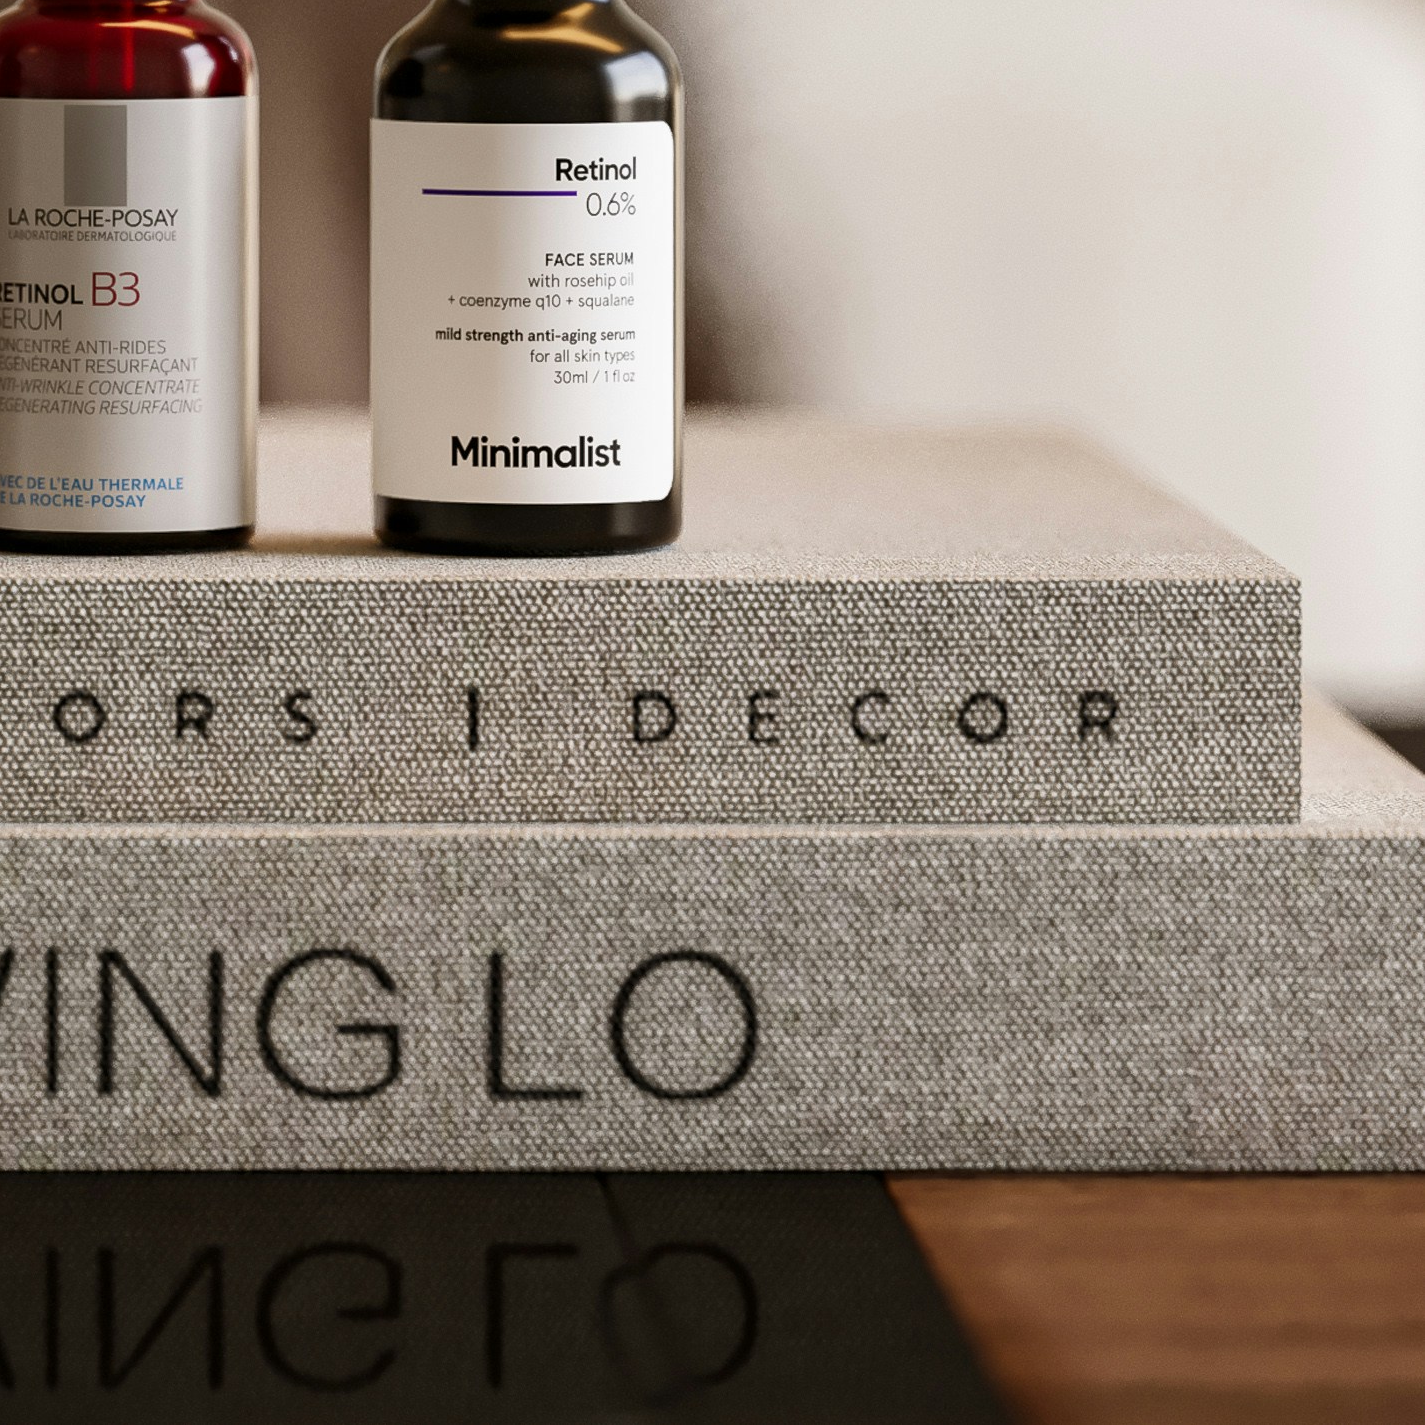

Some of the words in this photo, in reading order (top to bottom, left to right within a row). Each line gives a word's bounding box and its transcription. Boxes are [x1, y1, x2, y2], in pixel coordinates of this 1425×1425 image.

[555, 156, 637, 182] Retinol
[586, 191, 637, 217] 0.6%
[8, 208, 30, 226] LA
[35, 209, 178, 228] ROCHE-POSAY
[545, 253, 585, 267] FACE
[589, 252, 634, 267] SERUM
[91, 271, 141, 307] B3
[528, 274, 560, 288] with
[565, 273, 617, 291] rosehip
[620, 273, 635, 287] oil
[459, 296, 532, 311] coenzyme
[535, 294, 561, 311] q10
[578, 293, 635, 310] squalane
[435, 327, 461, 341] mild
[465, 329, 524, 345] strength
[527, 329, 597, 345] anti-aging
[600, 330, 636, 342] serum
[75, 340, 166, 355] ANTI-RIDES
[530, 349, 550, 363] for
[554, 349, 570, 363] all
[574, 349, 601, 363] skin
[604, 349, 636, 365] types
[85, 357, 198, 376] RESURFAÇANT
[553, 370, 588, 384] 30ml
[612, 370, 621, 383] fl
[623, 372, 636, 383] oz
[88, 379, 200, 395] CONCENTRATE
[99, 398, 203, 415] RESURFACING
[451, 435, 621, 468] Minimalist
[27, 477, 45, 490] DE
[49, 478, 94, 491] L'EAU
[99, 477, 184, 491] THERMALE
[9, 492, 26, 505] LA
[30, 493, 146, 508] ROCHE-POSAY
[631, 689, 1120, 746] DECOR
[488, 949, 758, 1101] LO
